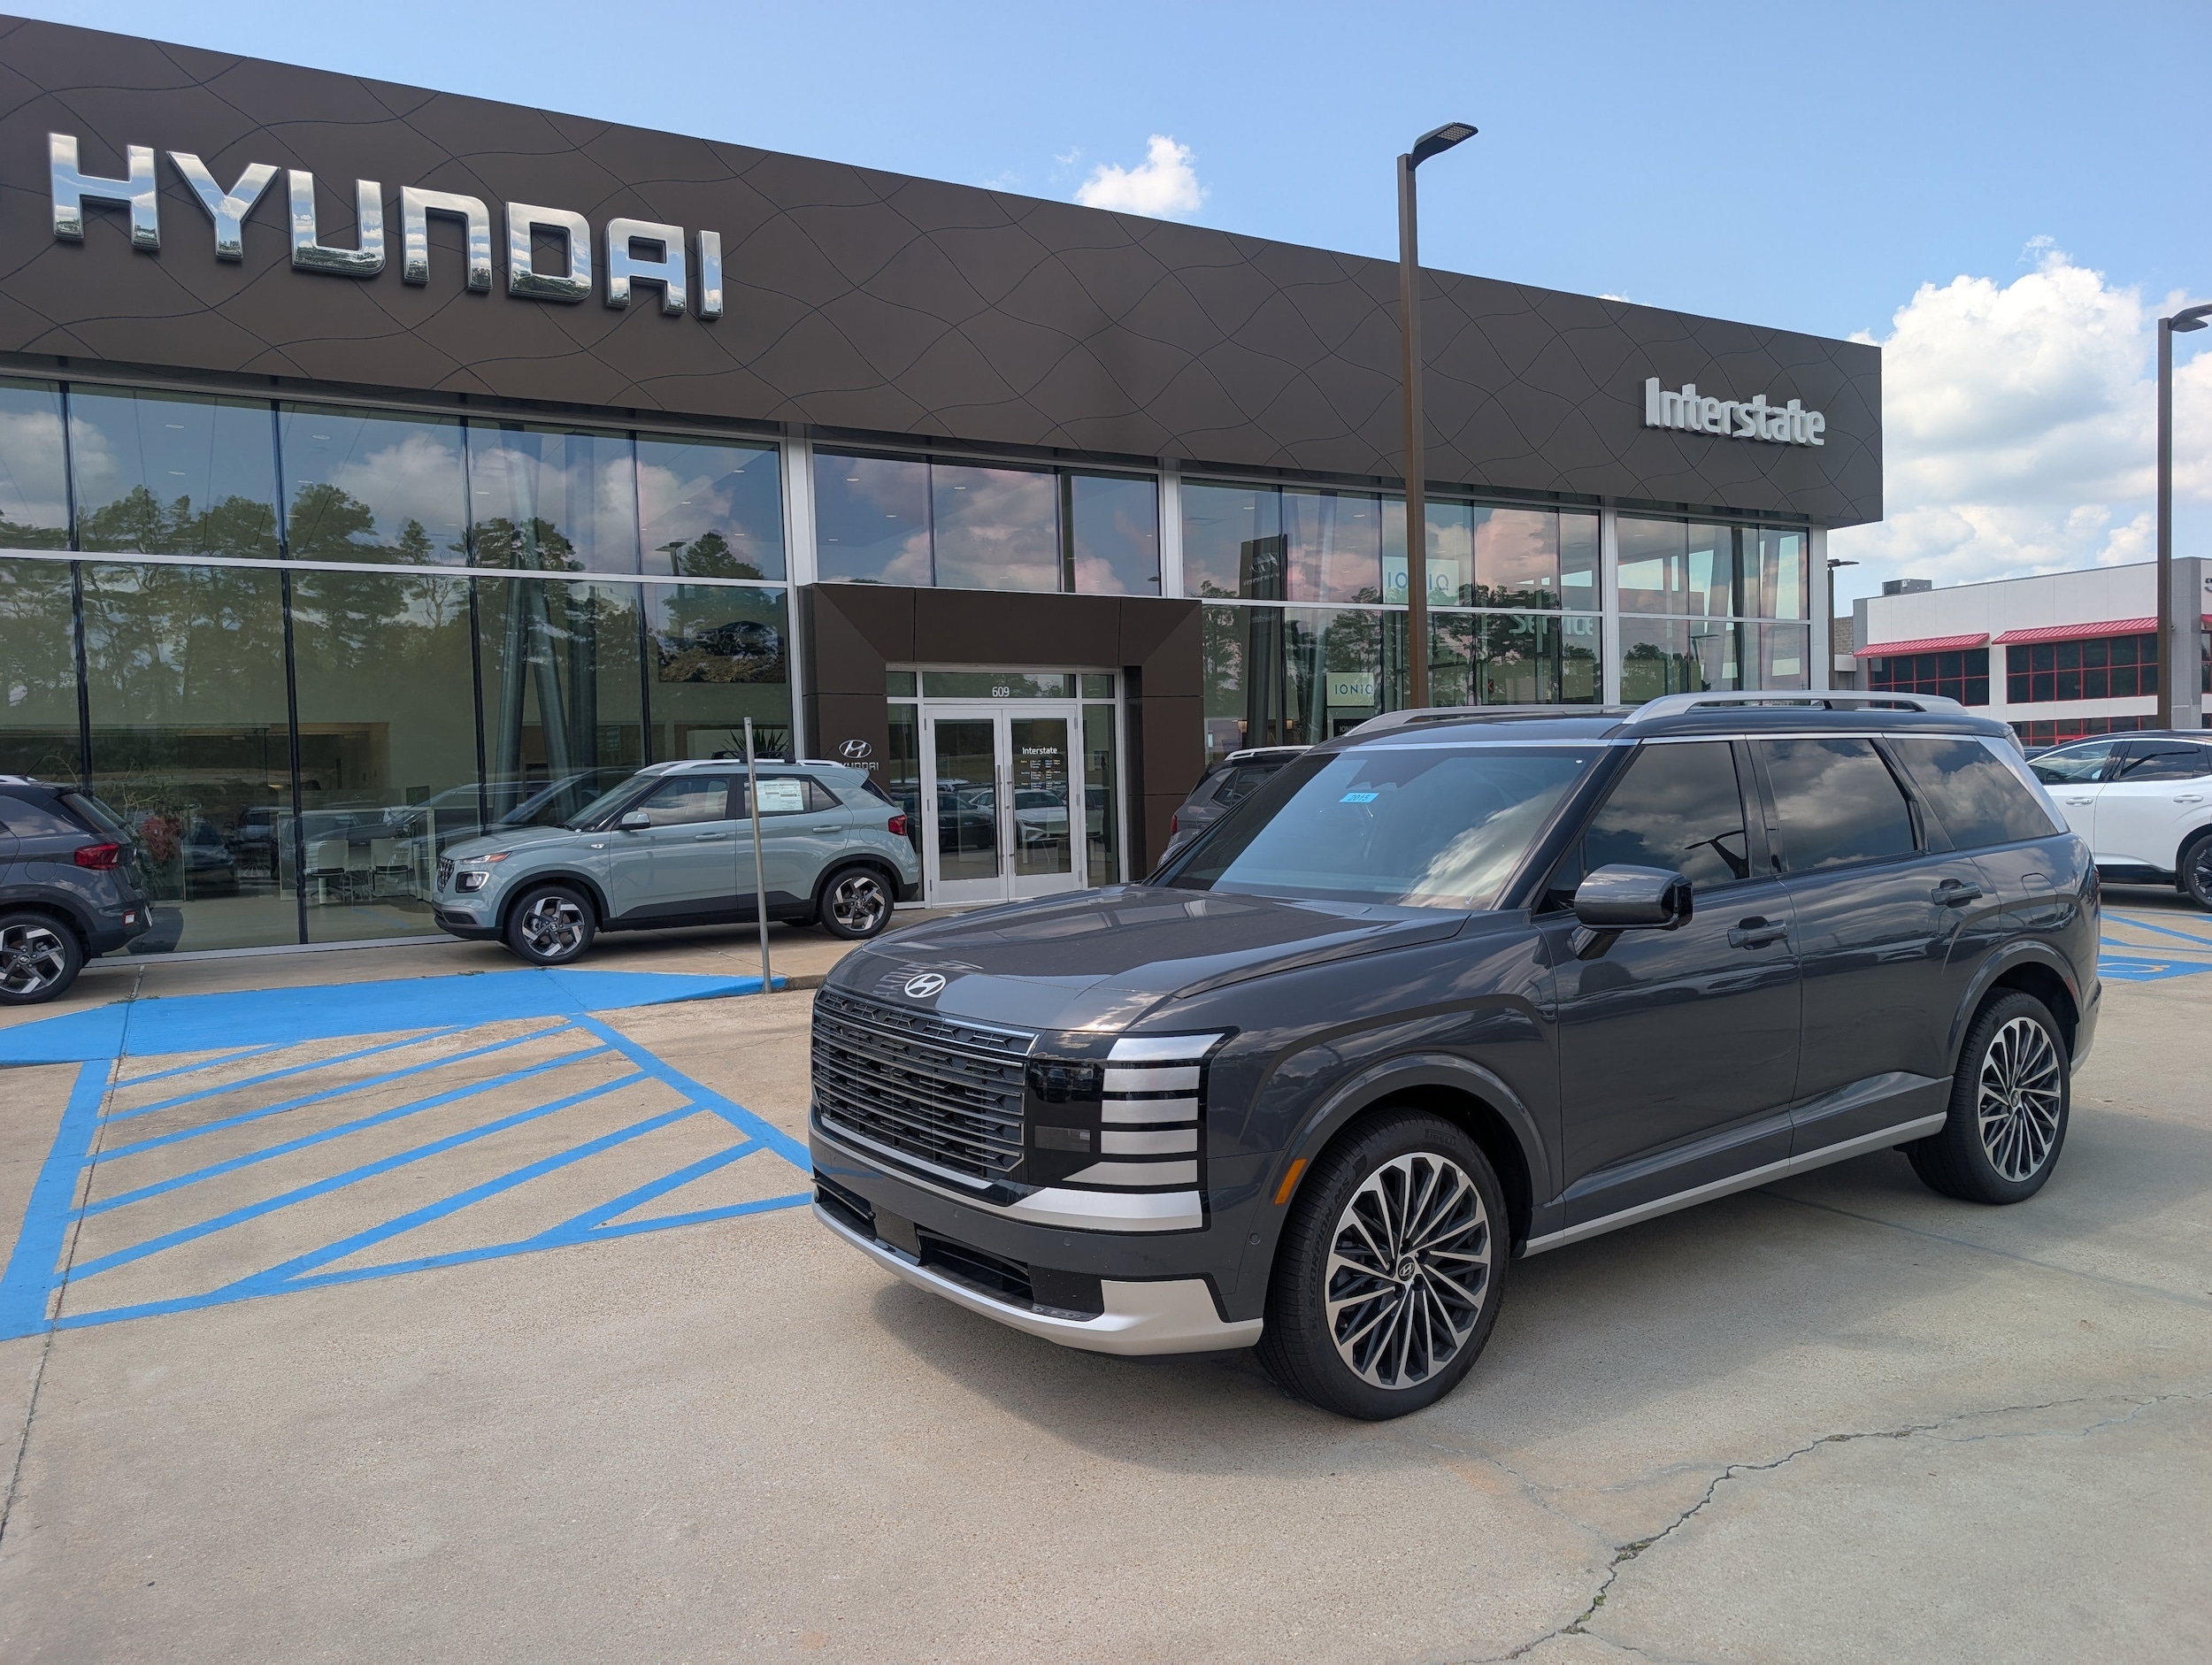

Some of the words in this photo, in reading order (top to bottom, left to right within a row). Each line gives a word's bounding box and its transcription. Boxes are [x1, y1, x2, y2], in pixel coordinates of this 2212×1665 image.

[49, 132, 724, 320] HYUNDAI
[1645, 377, 1826, 446] Interstate
[1387, 572, 1448, 591] IOIQ
[992, 686, 1010, 697] 609
[1334, 684, 1373, 694] IONIQ
